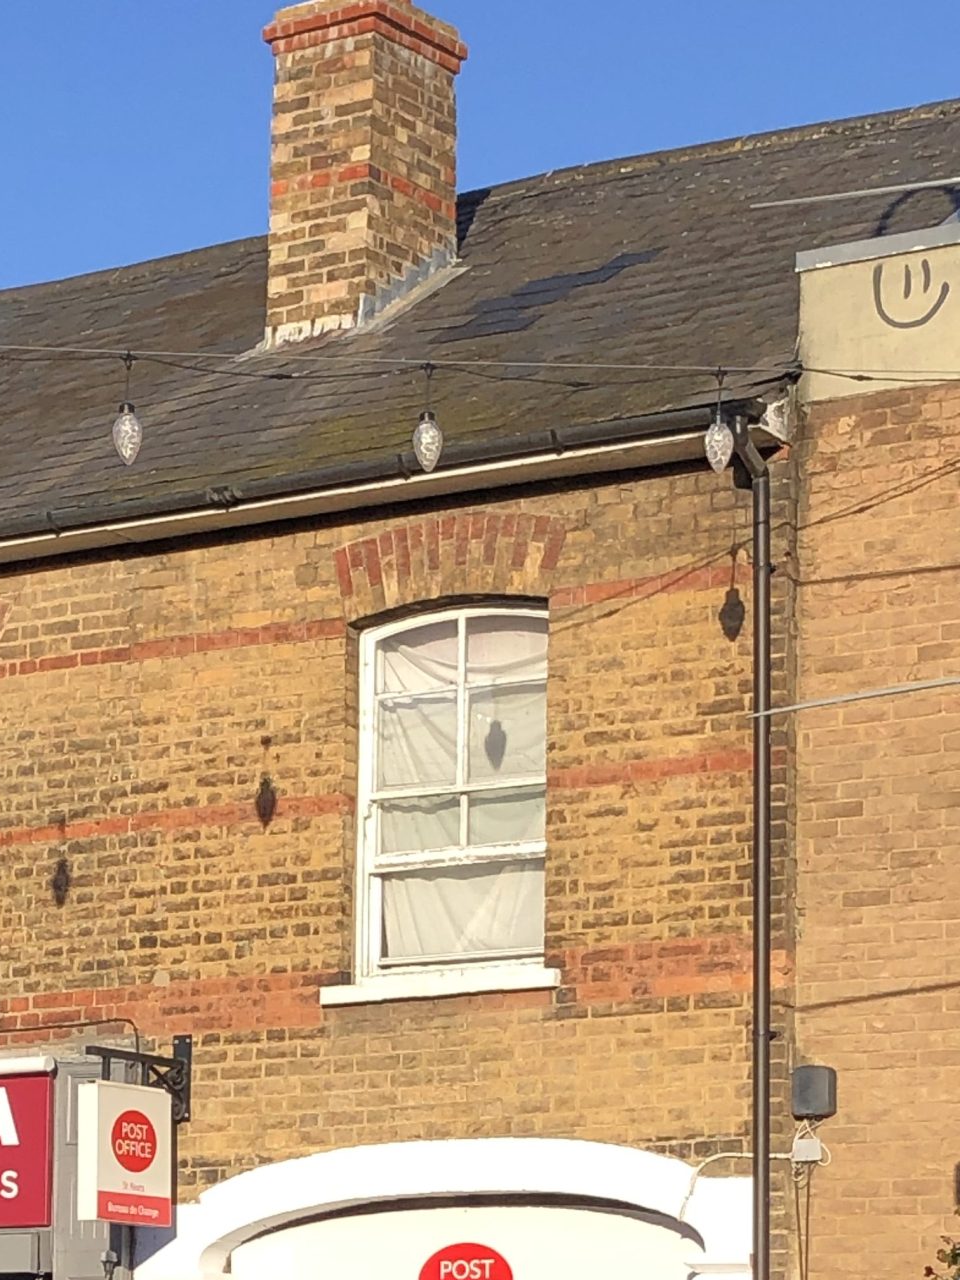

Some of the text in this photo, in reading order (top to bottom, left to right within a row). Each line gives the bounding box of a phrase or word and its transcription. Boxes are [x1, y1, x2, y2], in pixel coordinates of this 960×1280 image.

[121, 1121, 148, 1140] POST
[115, 1139, 152, 1158] OFFICE
[440, 1259, 495, 1280] POST
